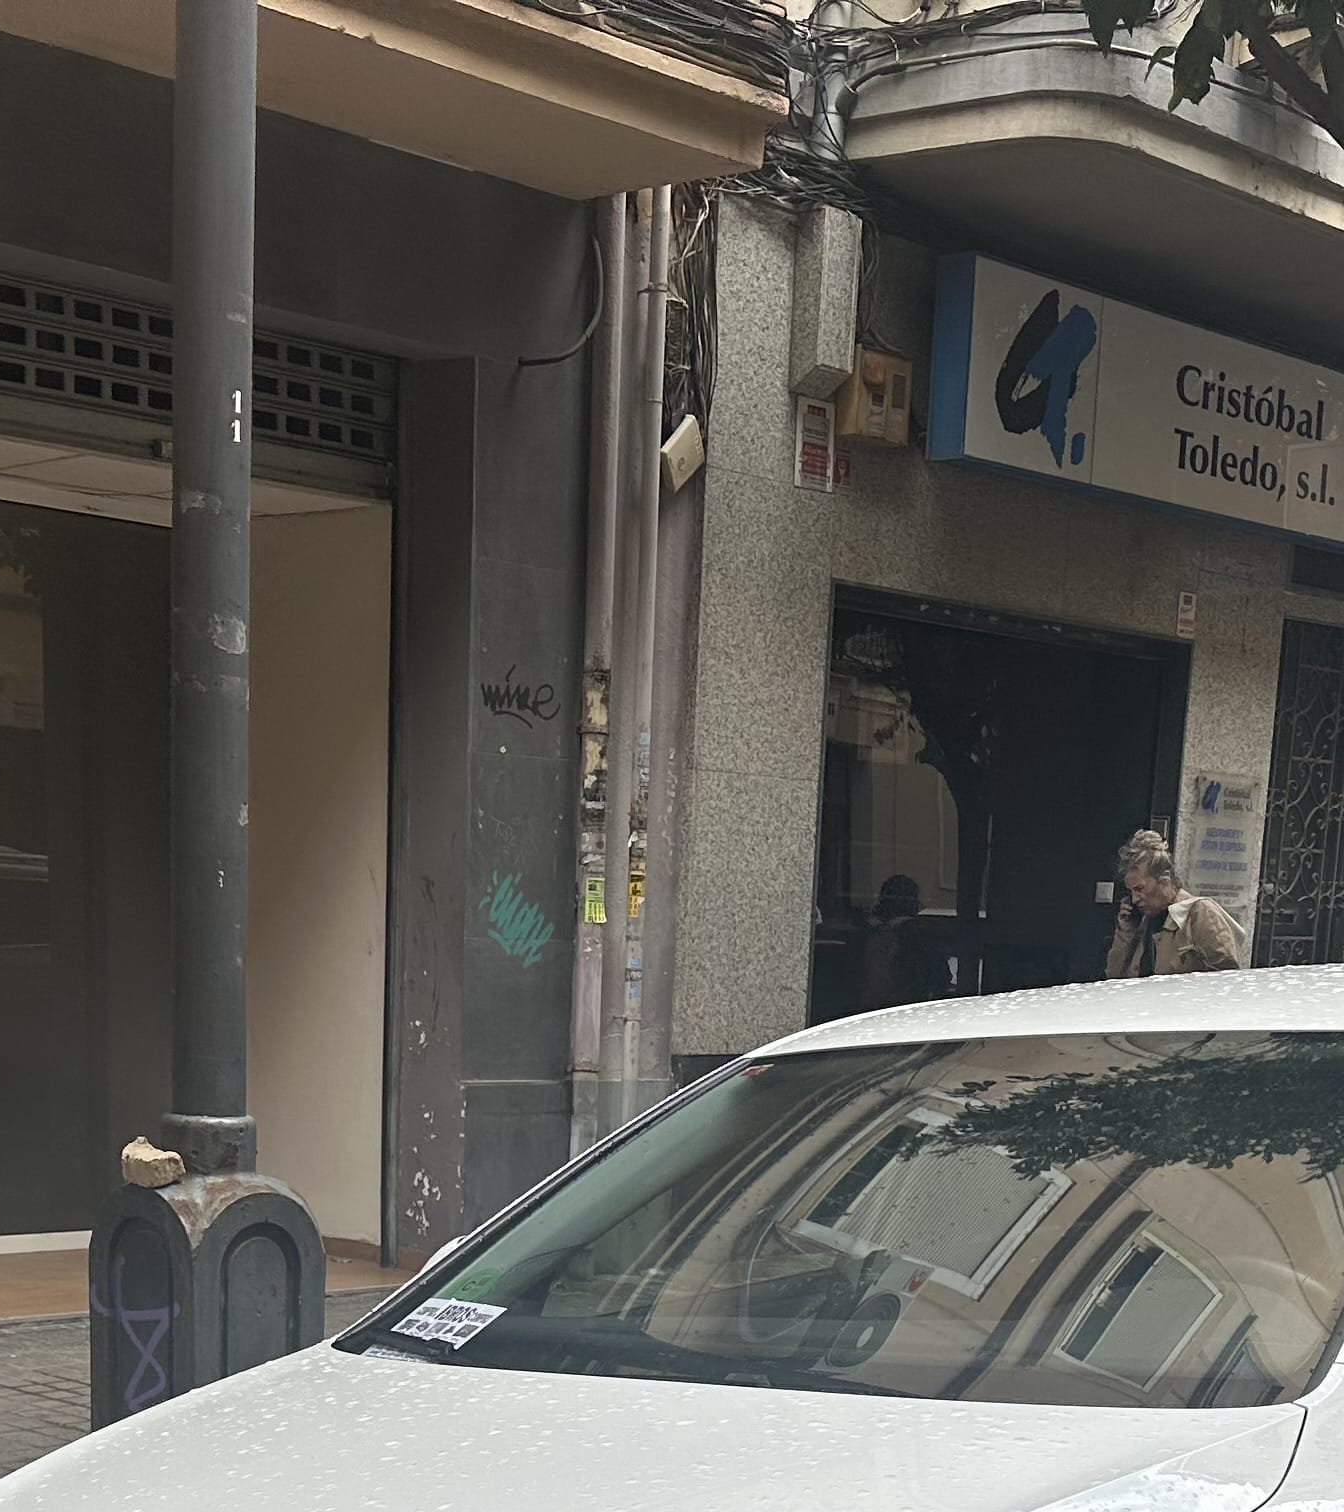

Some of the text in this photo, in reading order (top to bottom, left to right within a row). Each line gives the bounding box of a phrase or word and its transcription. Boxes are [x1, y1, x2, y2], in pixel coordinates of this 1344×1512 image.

[1175, 364, 1325, 441] Cristóbal
[1174, 427, 1335, 506] Toledo, s.l.
